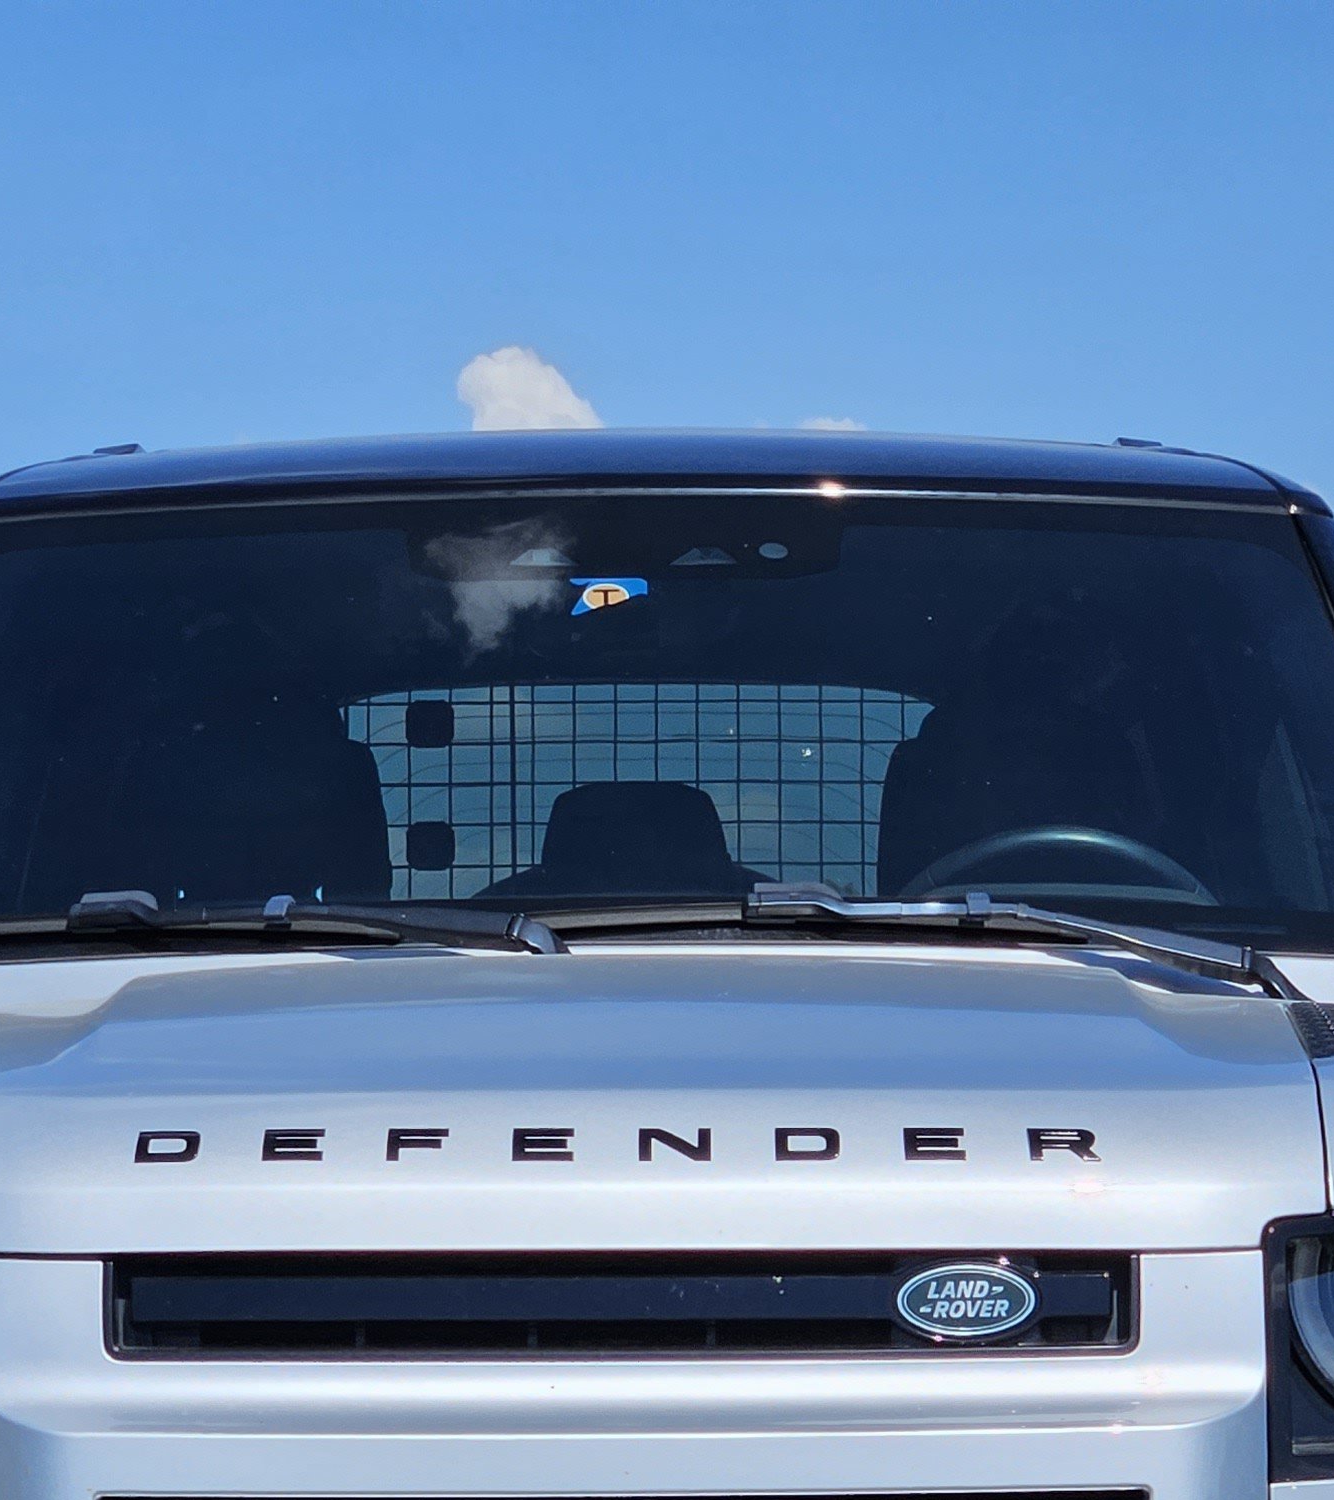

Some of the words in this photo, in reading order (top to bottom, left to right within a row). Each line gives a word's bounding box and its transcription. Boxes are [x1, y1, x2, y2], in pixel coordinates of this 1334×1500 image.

[134, 1127, 1100, 1163] DEFENDER
[927, 1280, 990, 1300] LAND
[932, 1299, 1010, 1318] ROVER
